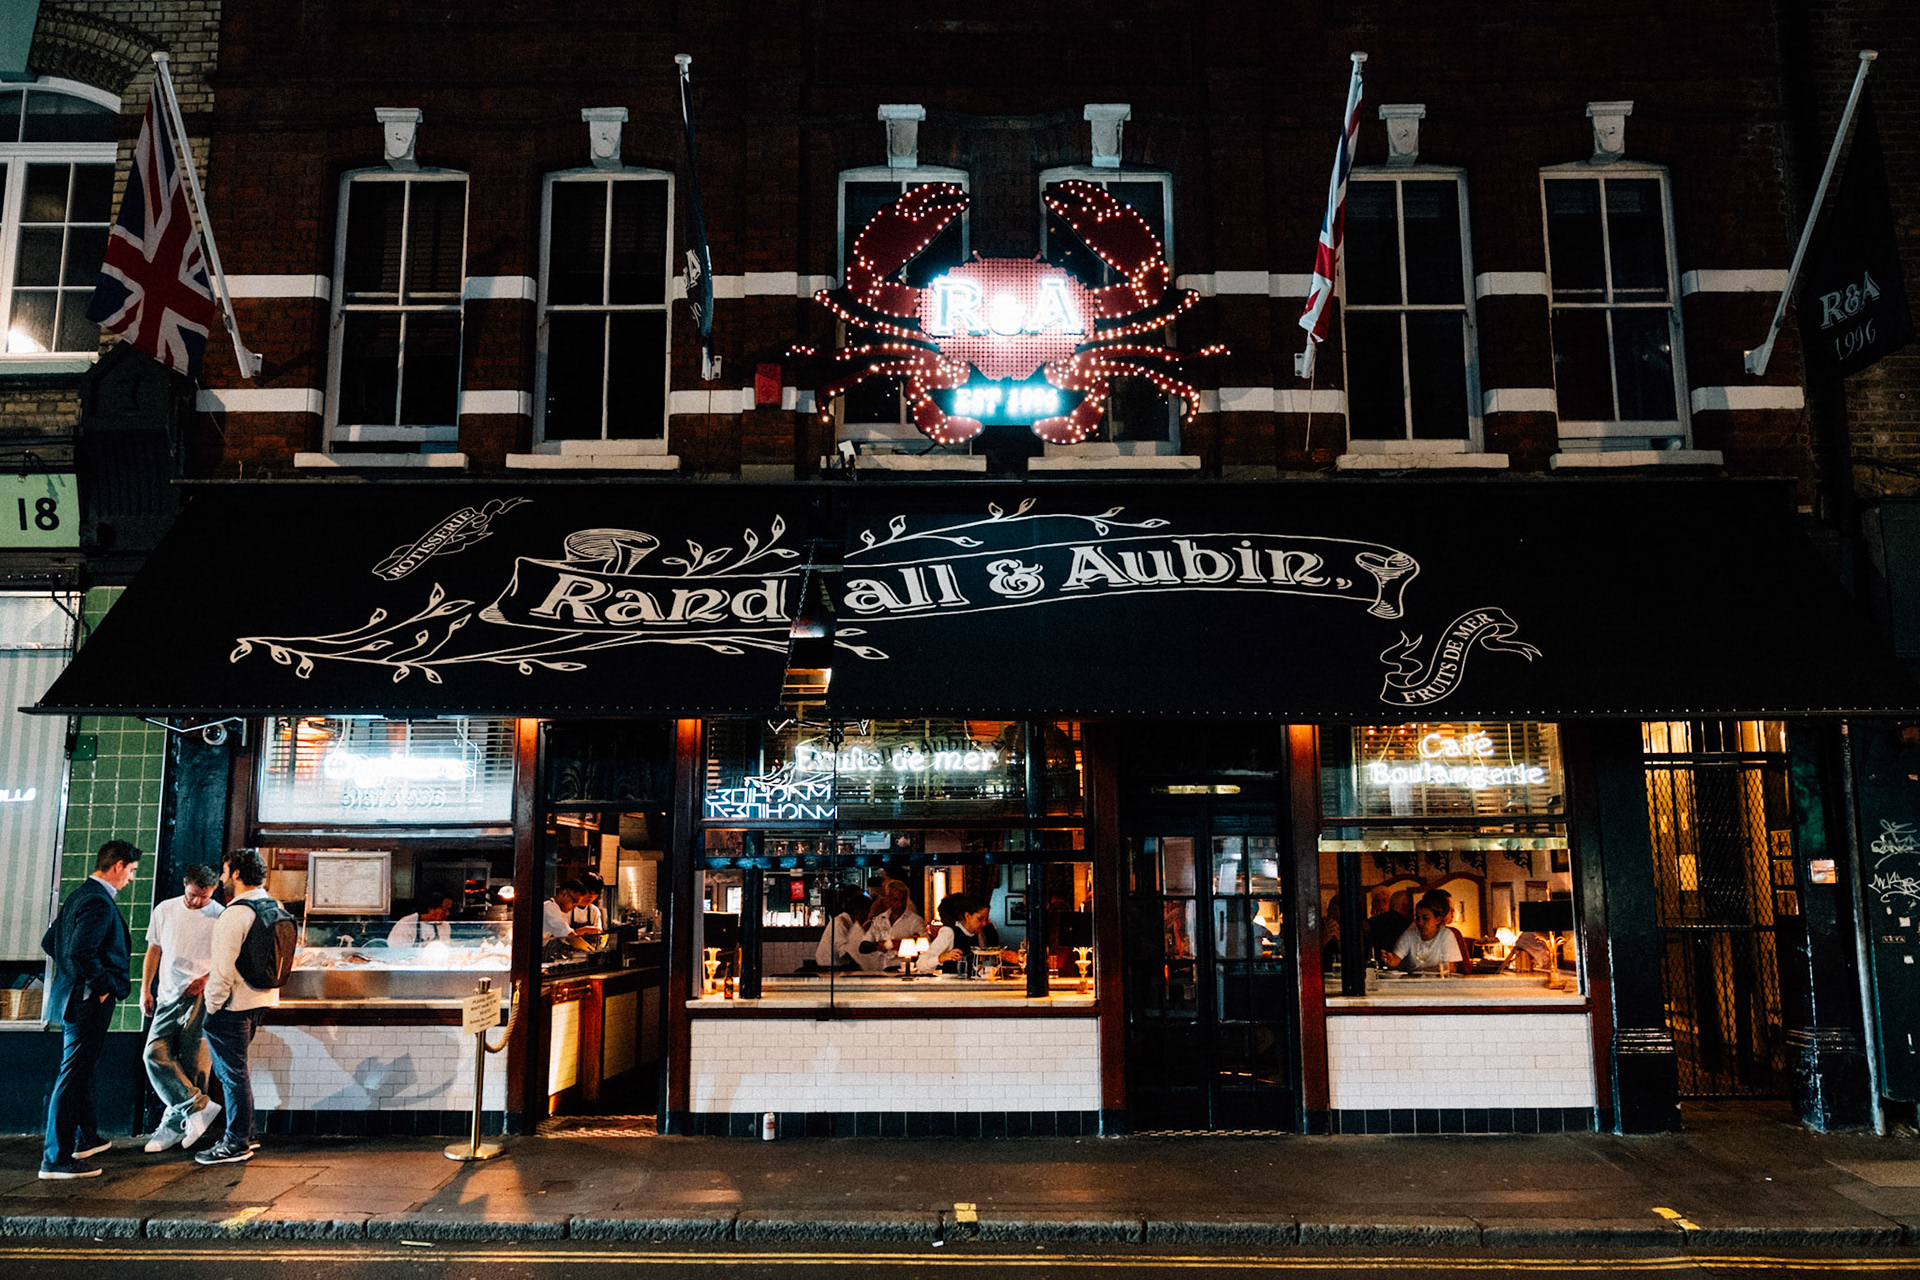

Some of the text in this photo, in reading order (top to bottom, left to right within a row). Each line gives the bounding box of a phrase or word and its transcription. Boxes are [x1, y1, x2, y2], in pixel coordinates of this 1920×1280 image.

[1818, 271, 1880, 330] R&A
[1834, 318, 1876, 361] 1996
[18, 497, 60, 531] 18
[387, 510, 475, 577] ROTISSERIE
[986, 559, 1044, 598] &
[1401, 613, 1495, 703] FRUITS DE MER
[892, 745, 925, 771] de
[933, 750, 999, 771] mer
